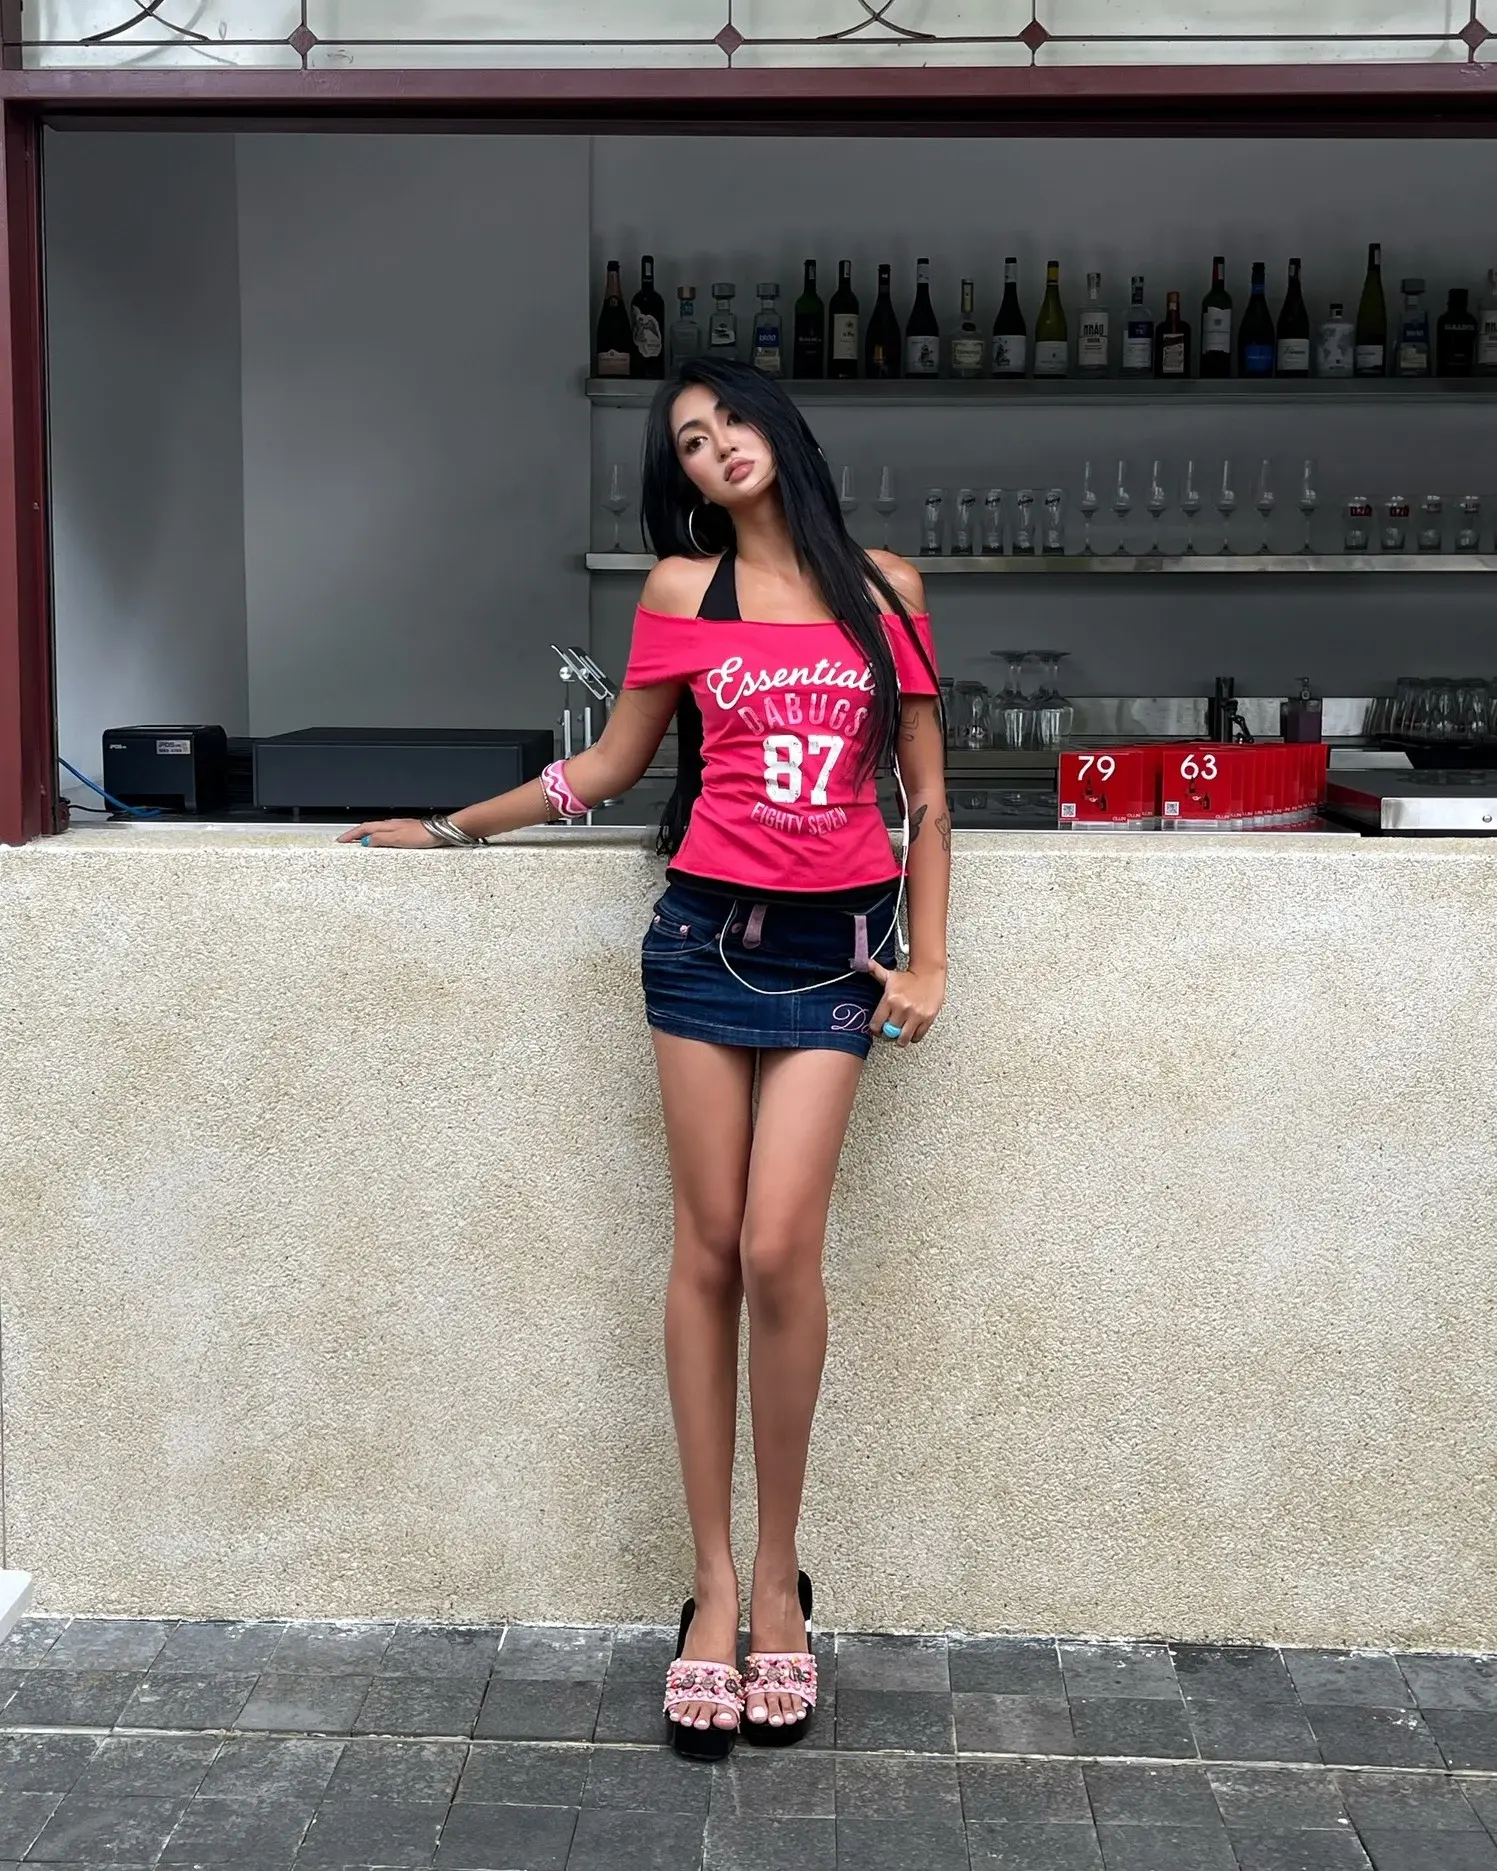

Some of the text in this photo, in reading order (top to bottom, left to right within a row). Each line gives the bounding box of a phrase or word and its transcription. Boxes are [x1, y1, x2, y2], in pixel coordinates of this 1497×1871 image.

[706, 656, 877, 710] Essential
[737, 692, 869, 737] DABUGS
[762, 734, 845, 806] 87
[1077, 755, 1116, 782] 79
[1180, 753, 1218, 780] 63
[751, 801, 849, 836] EIGHTY SEVEN
